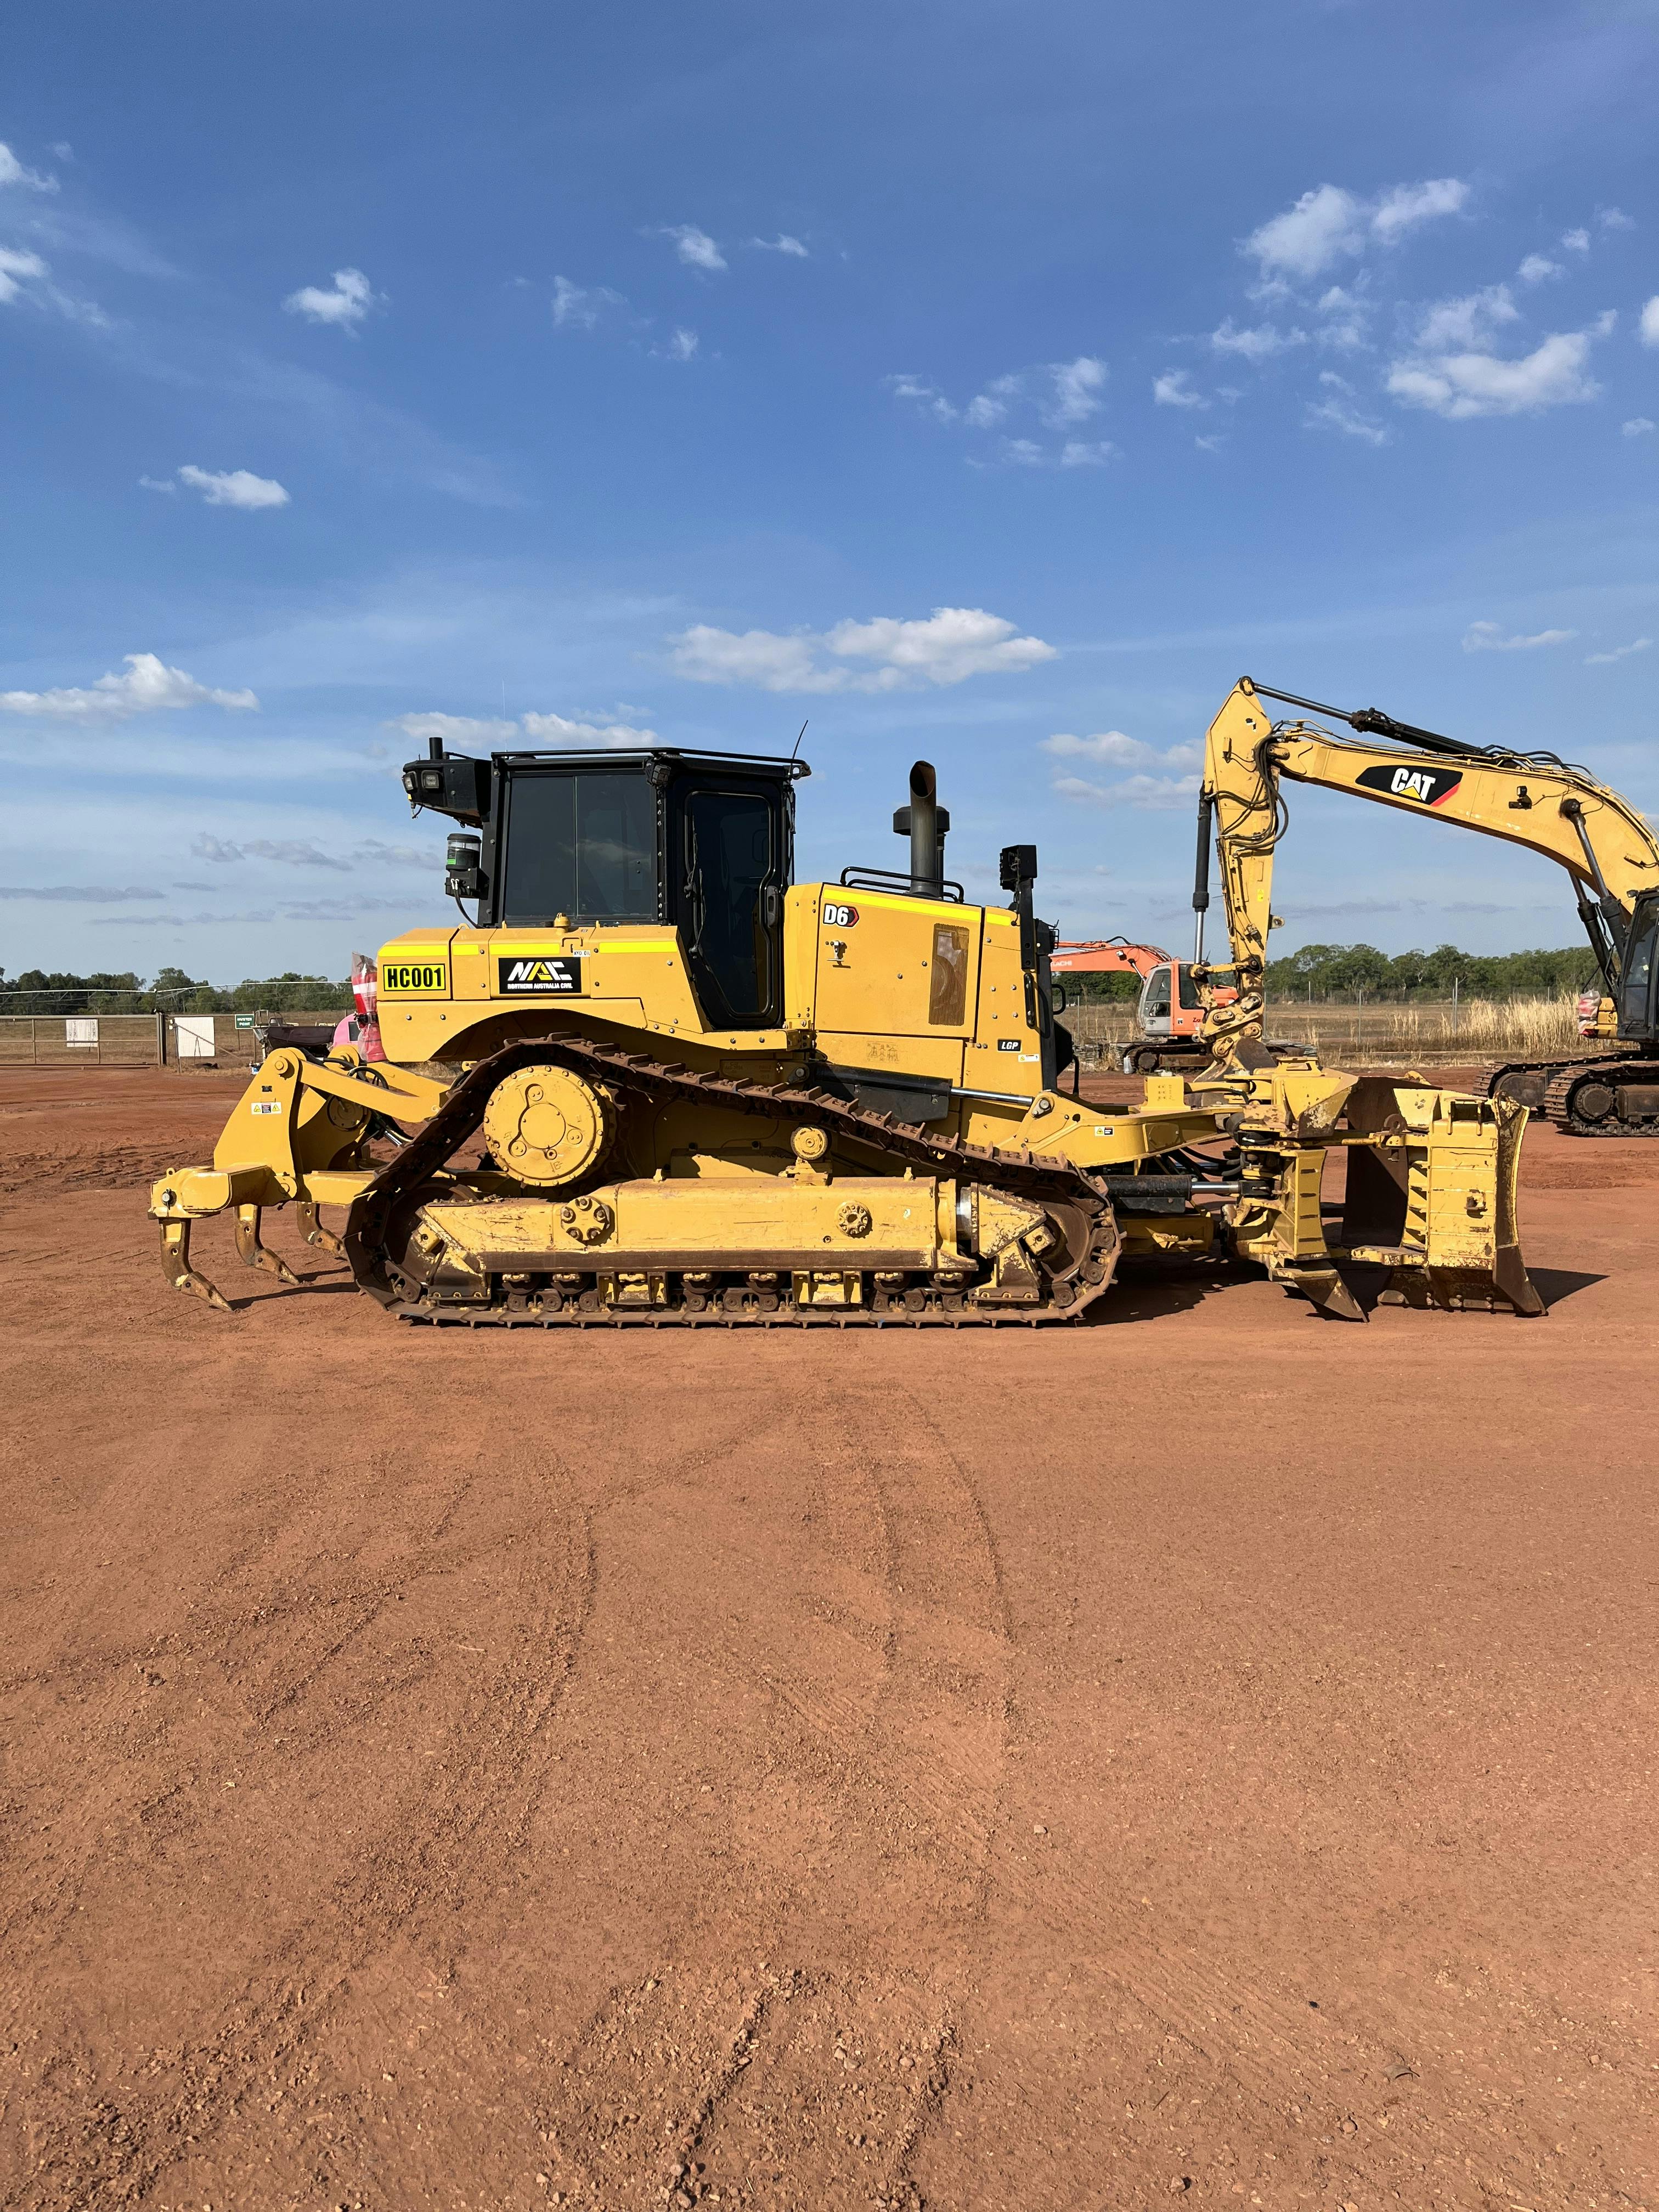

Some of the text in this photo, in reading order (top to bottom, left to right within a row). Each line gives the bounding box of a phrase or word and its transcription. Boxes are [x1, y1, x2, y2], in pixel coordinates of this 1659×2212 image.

[1391, 768, 1436, 802] CAT
[823, 904, 849, 926] D6
[387, 967, 442, 988] HC001
[507, 961, 573, 981] NAC
[1001, 1041, 1019, 1050] LGP
